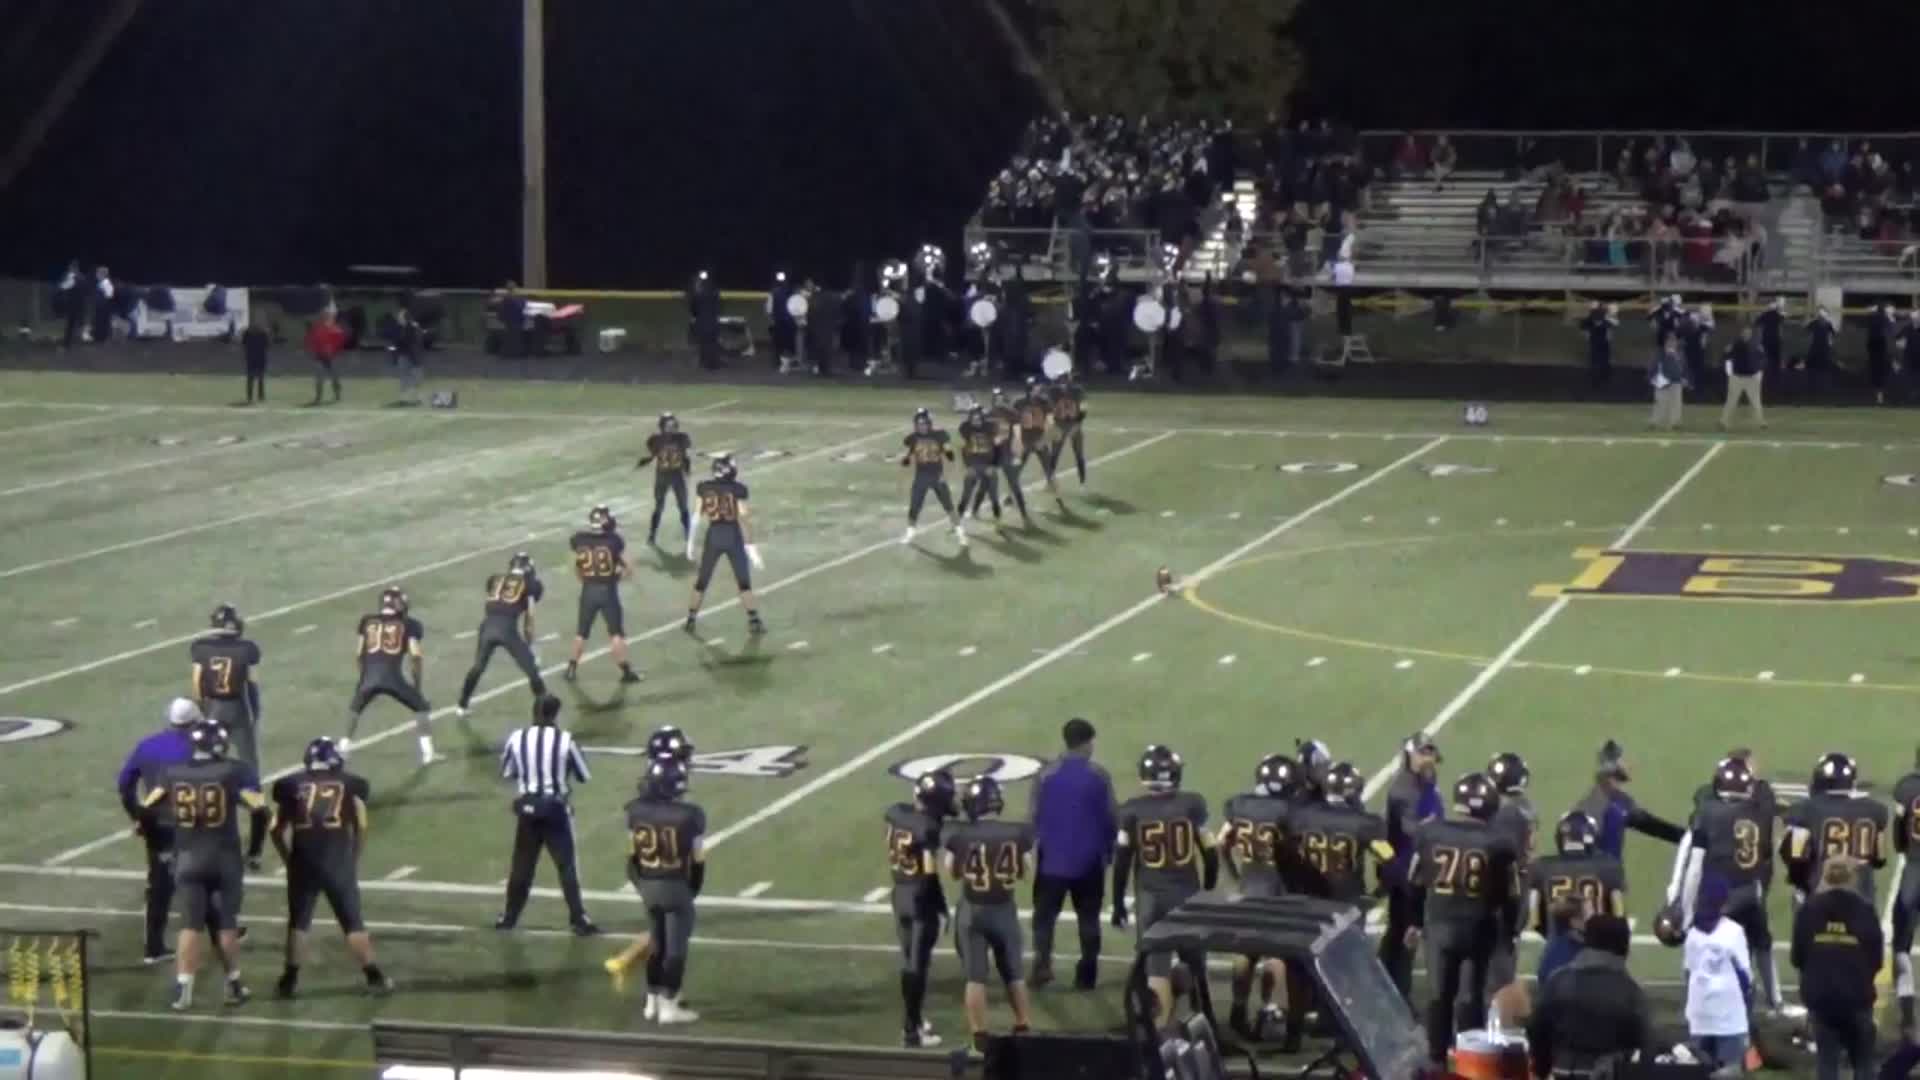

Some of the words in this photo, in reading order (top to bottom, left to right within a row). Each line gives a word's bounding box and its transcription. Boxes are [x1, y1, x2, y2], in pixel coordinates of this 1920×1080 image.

[209, 656, 233, 694] 7
[633, 825, 681, 869] 21
[964, 840, 1018, 892] 44
[1137, 817, 1193, 868] 50
[1733, 818, 1761, 870] 3
